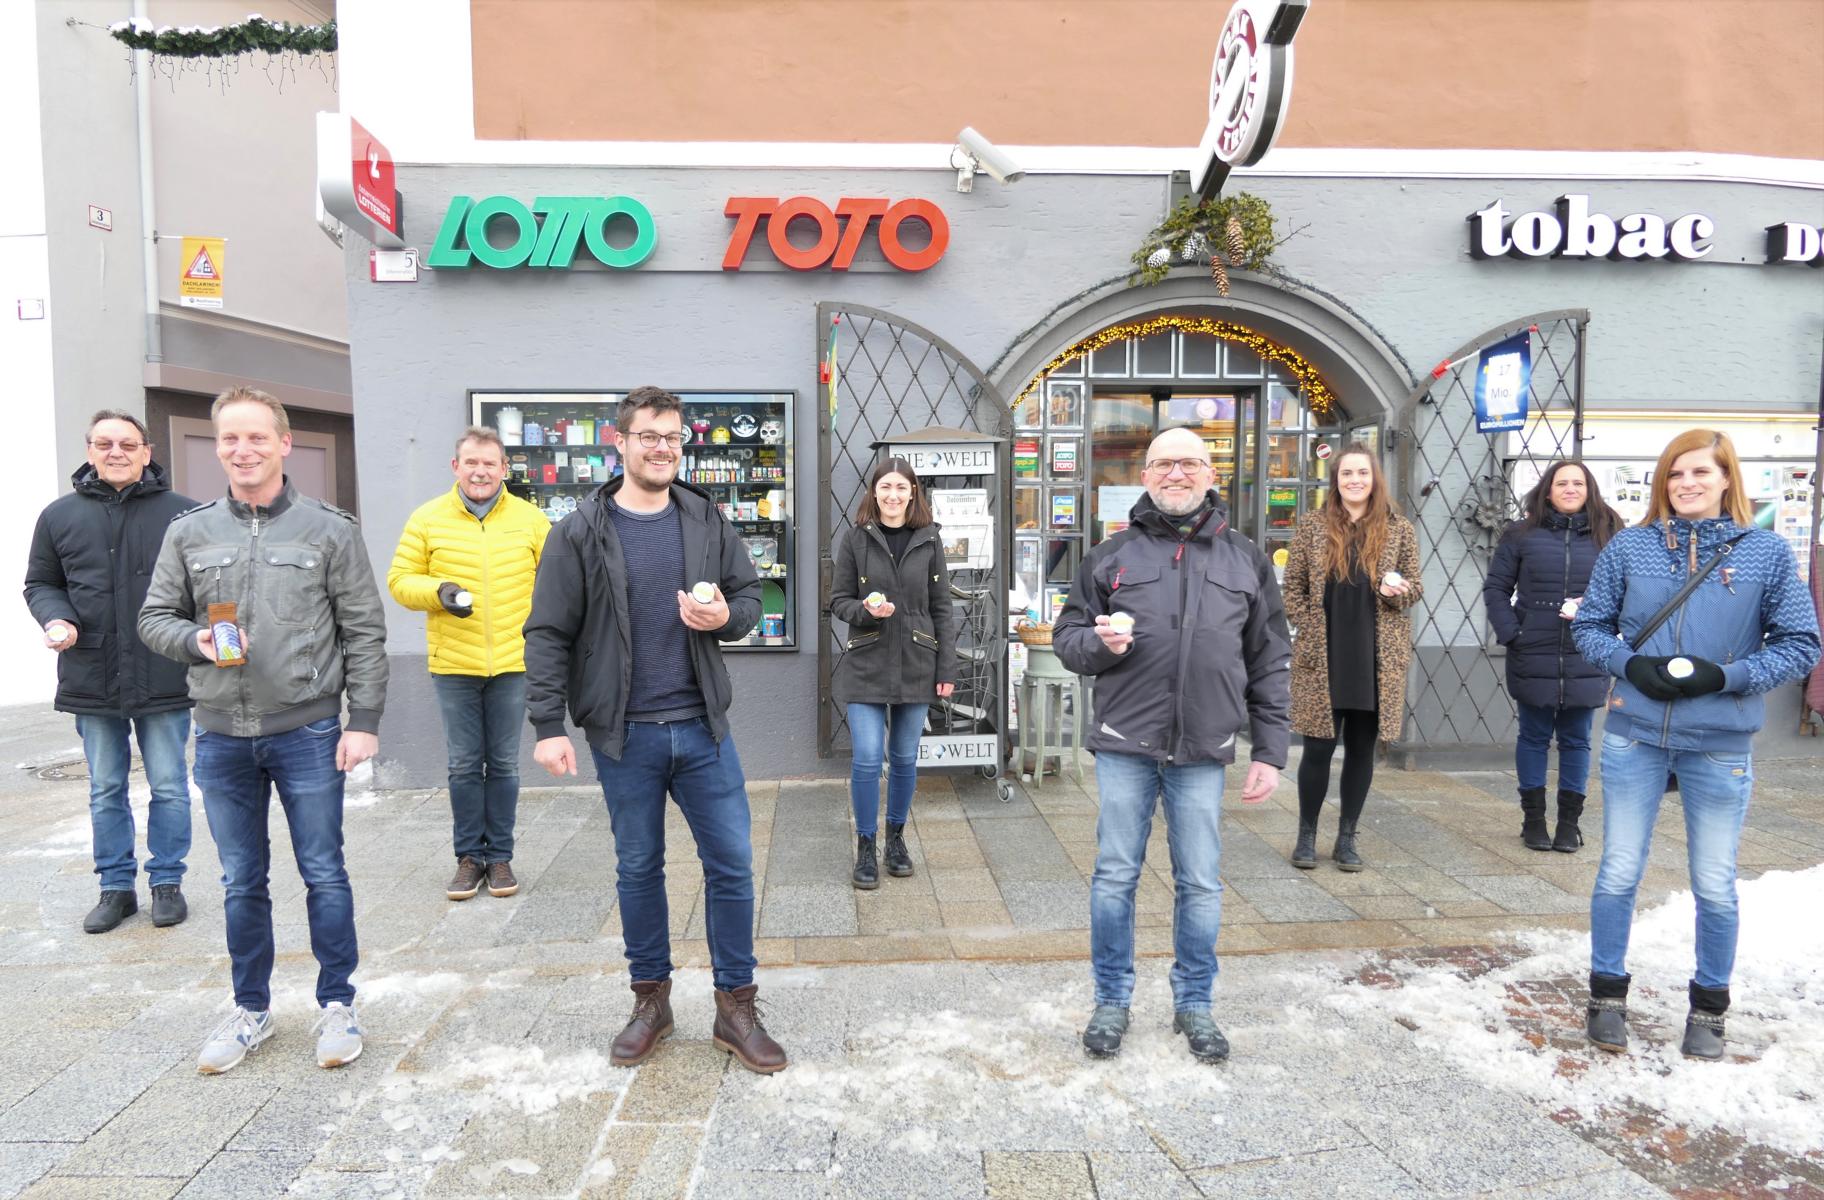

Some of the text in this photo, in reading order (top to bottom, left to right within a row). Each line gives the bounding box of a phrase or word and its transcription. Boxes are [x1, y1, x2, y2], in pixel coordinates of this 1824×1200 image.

[97, 210, 104, 221] 3
[358, 193, 391, 225] LOTTERIEN
[427, 195, 657, 270] LOTTO
[721, 196, 950, 272] TOTO
[1476, 194, 1824, 262] tobac D
[405, 252, 414, 269] 5
[1498, 363, 1511, 376] 17
[943, 451, 992, 467] WELT
[947, 742, 995, 758] WELT
